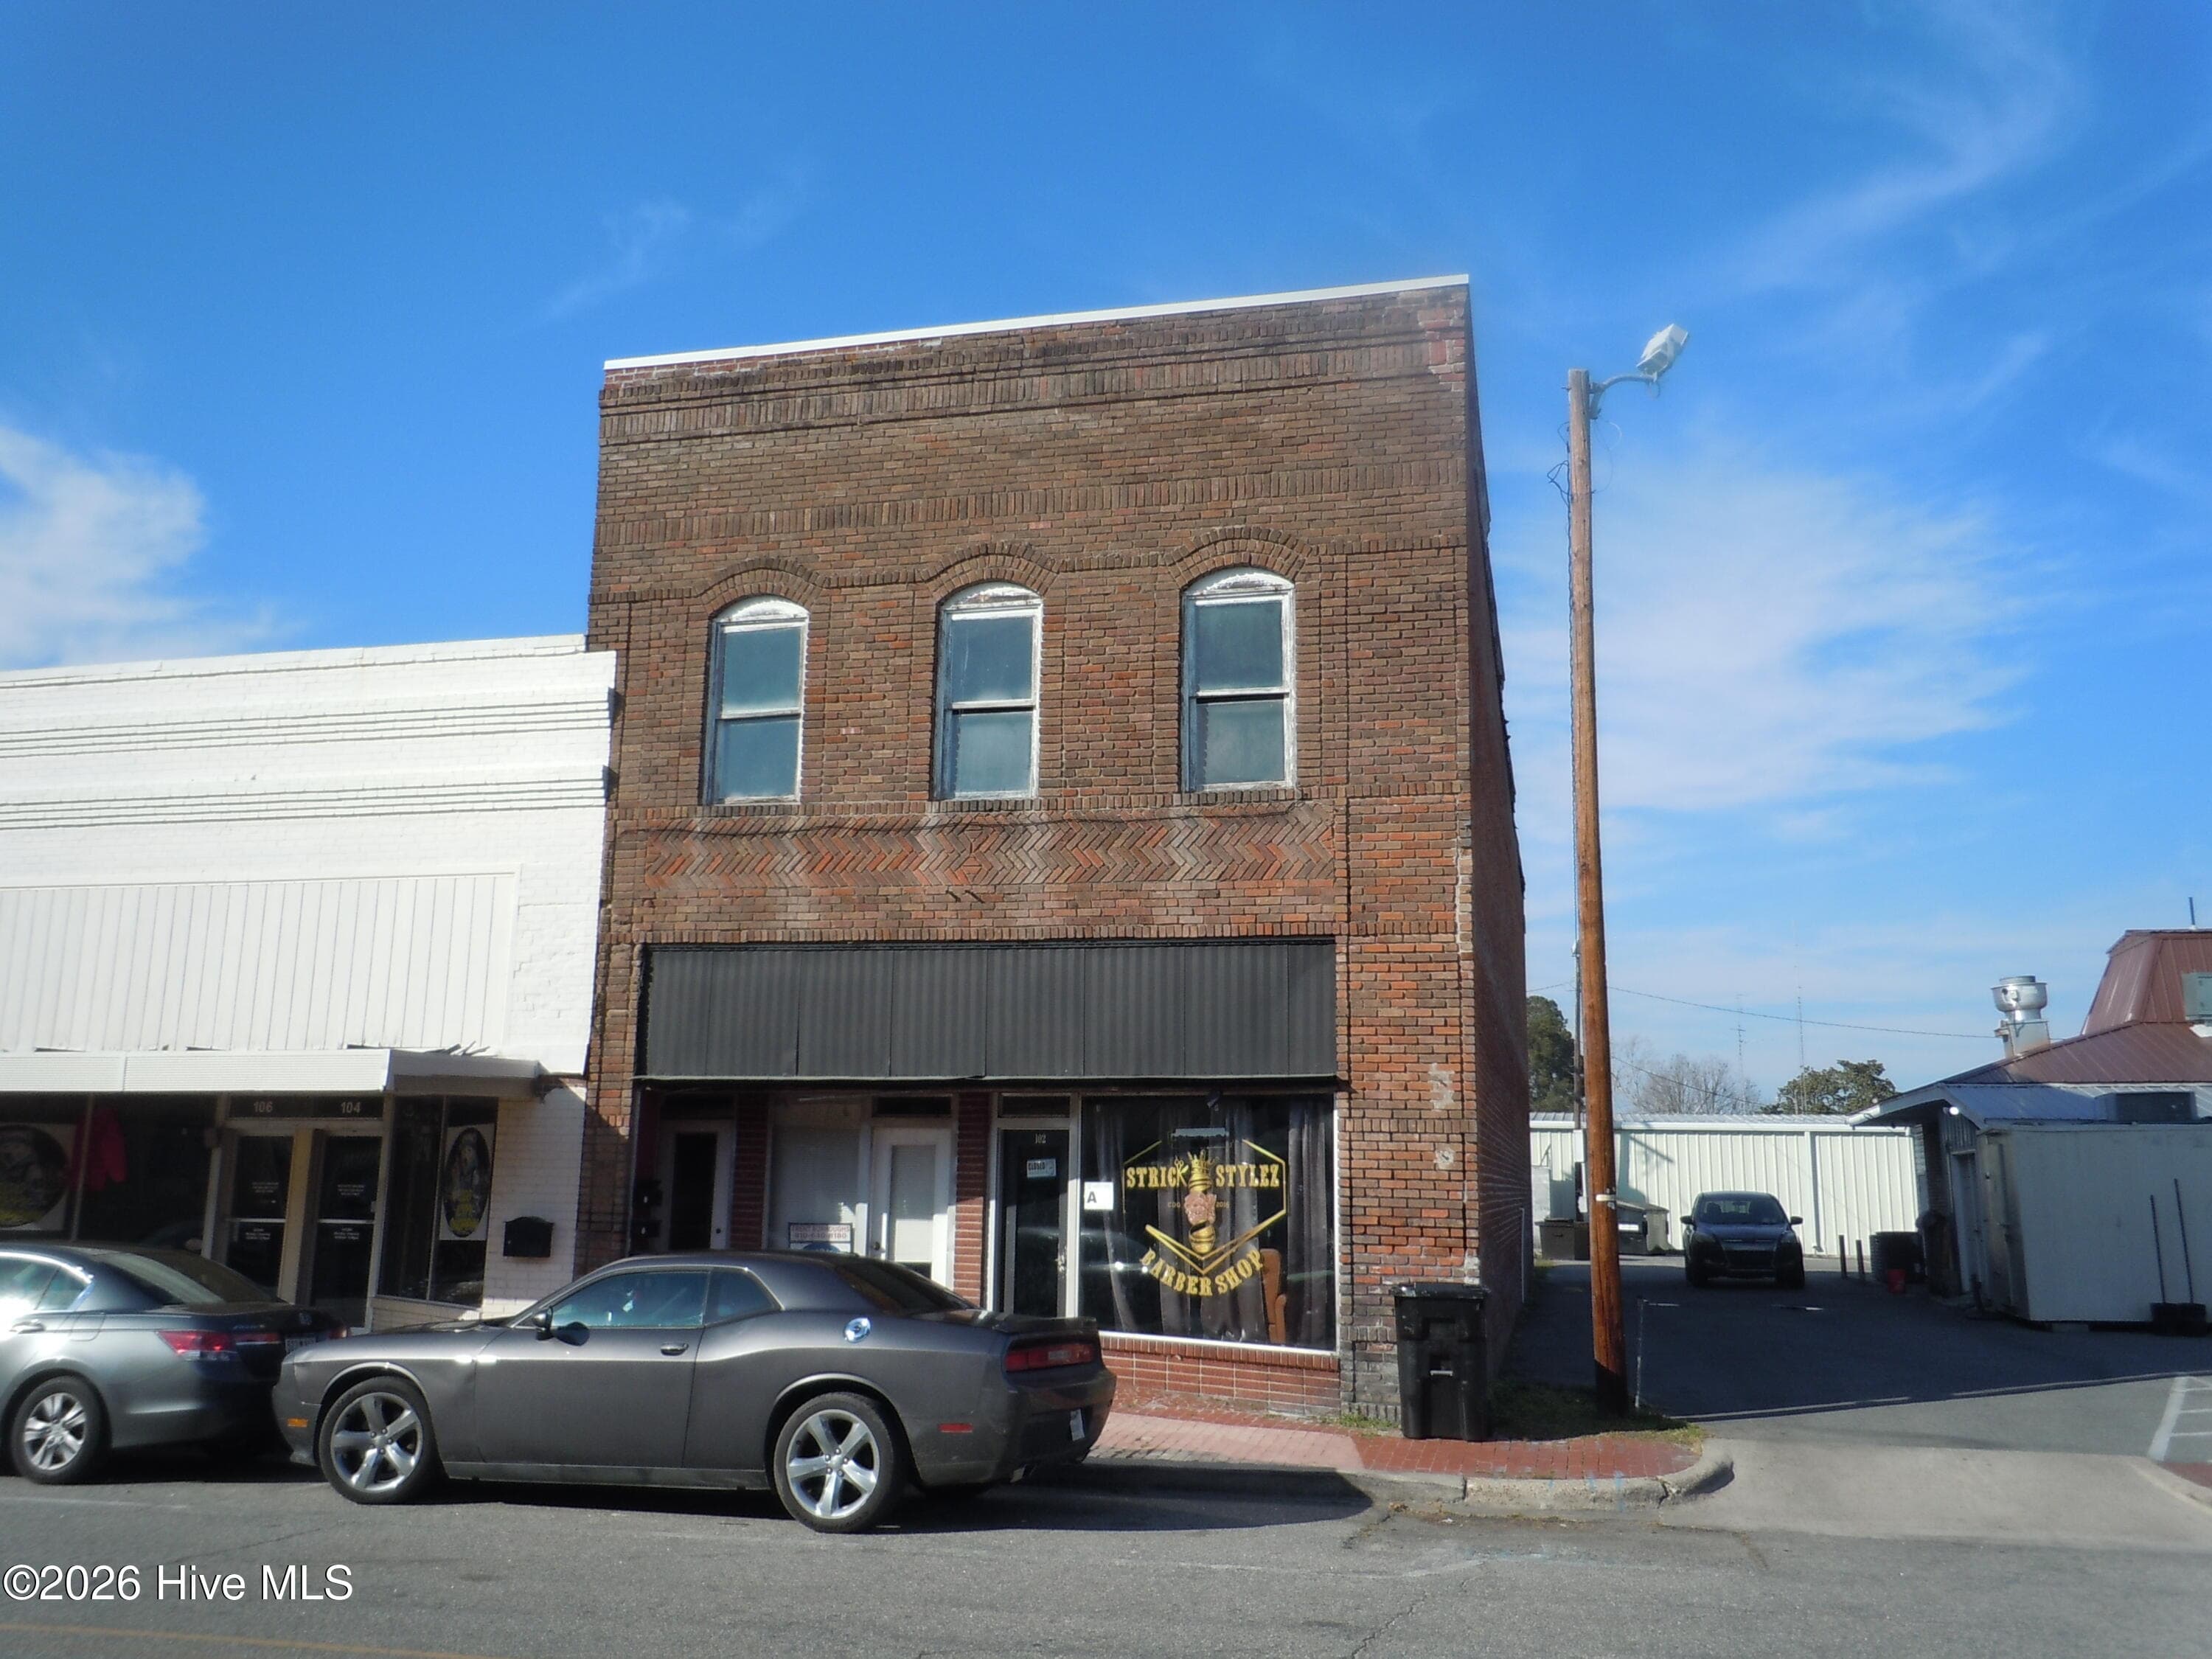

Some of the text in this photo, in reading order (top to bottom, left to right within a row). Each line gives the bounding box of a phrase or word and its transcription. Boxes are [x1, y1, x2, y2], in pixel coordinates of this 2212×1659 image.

[254, 1101, 273, 1113] 106
[341, 1102, 361, 1113] 104
[1035, 1134, 1046, 1144] 102
[1216, 1164, 1279, 1187] STYLEZ
[1087, 1192, 1097, 1203] A
[1139, 1248, 1263, 1296] BARBER SHOP
